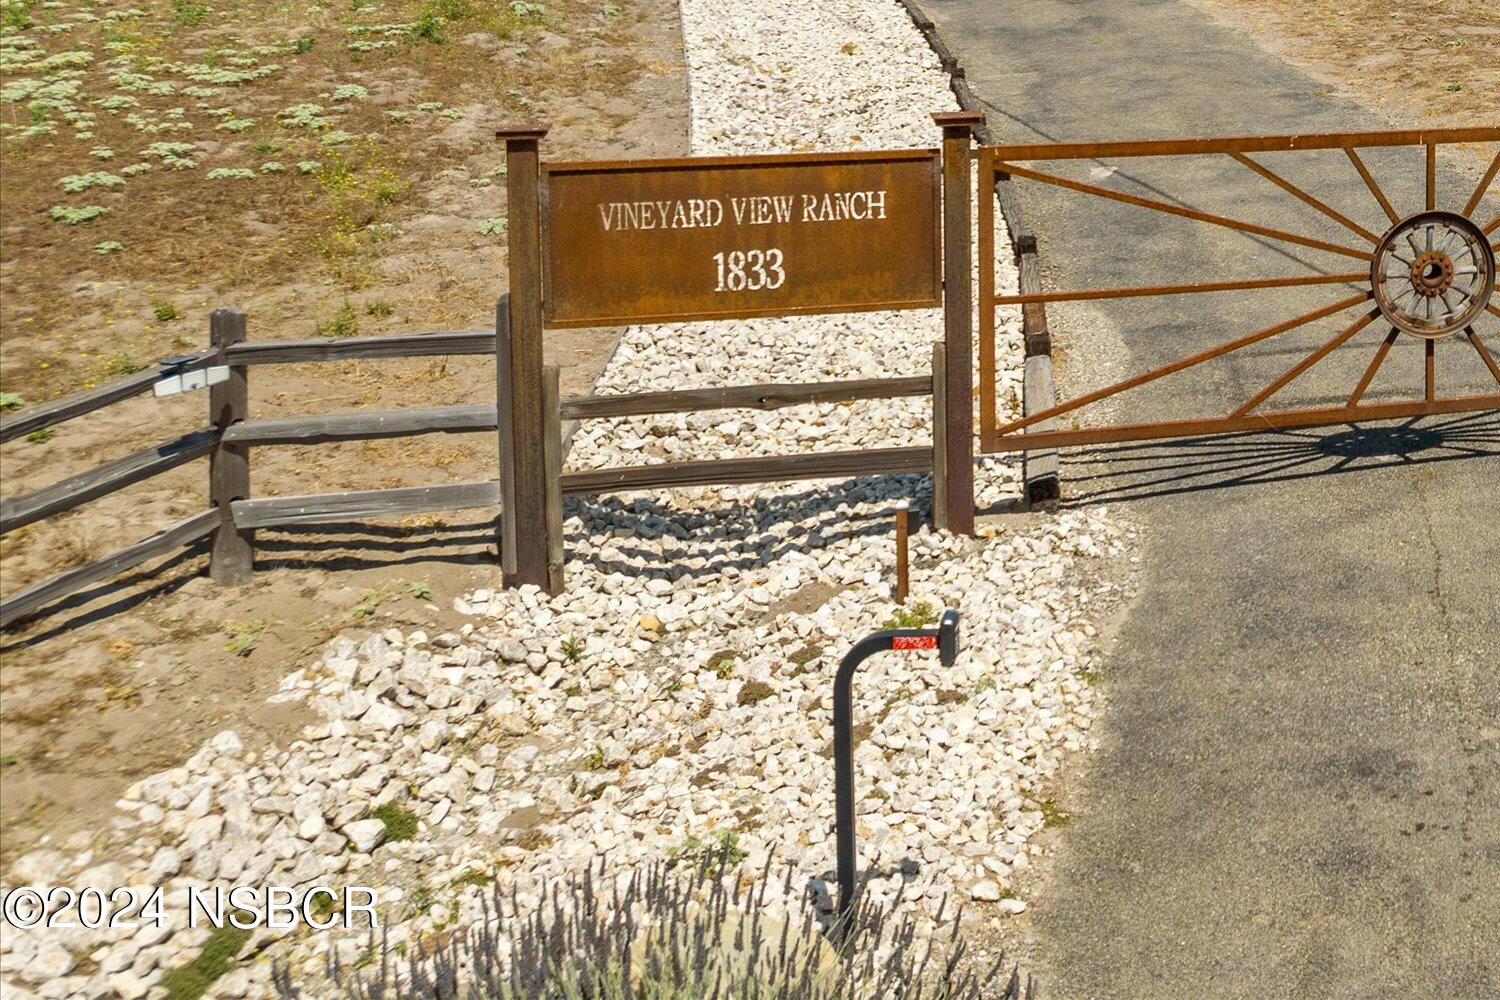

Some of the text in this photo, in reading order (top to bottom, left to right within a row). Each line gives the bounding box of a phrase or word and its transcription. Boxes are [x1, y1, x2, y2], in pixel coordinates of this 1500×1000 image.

[598, 191, 887, 231] VINEYARD VIEW RANCH
[713, 248, 786, 292] 1833
